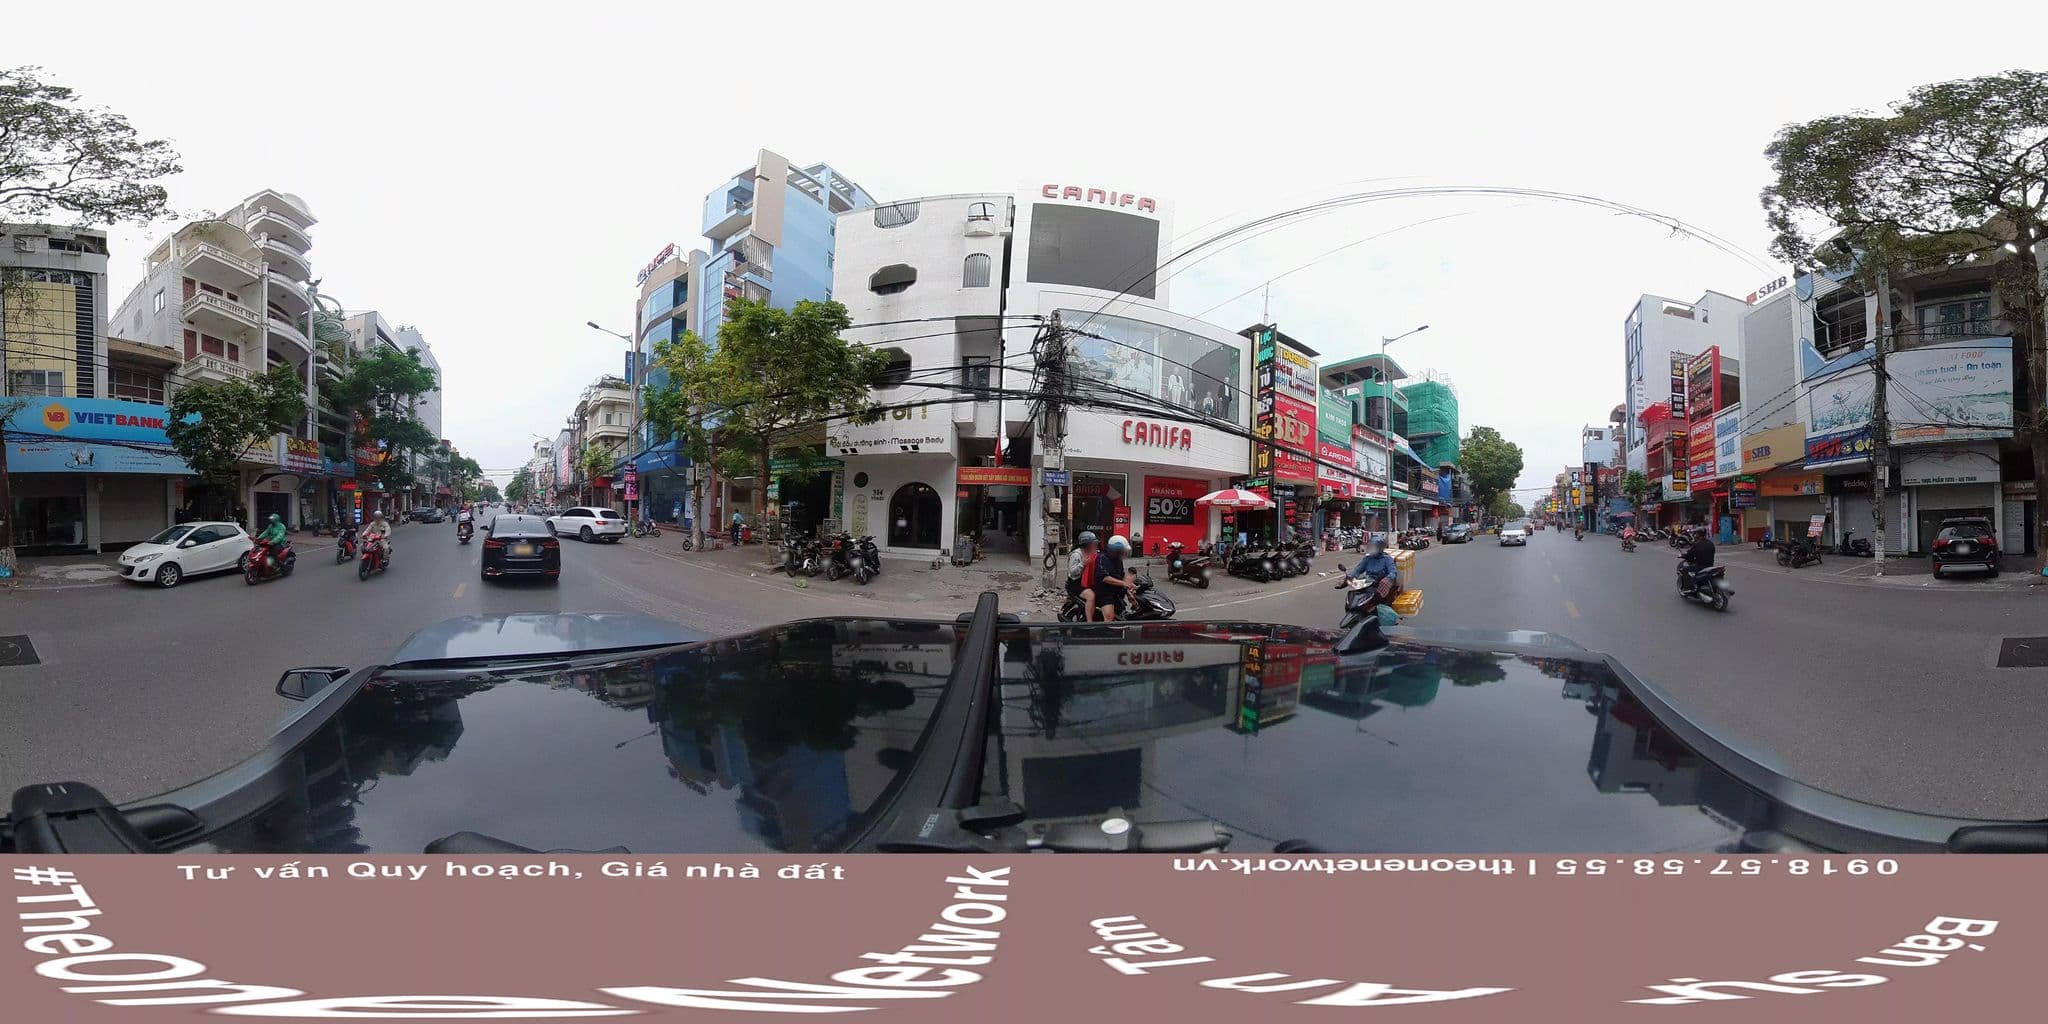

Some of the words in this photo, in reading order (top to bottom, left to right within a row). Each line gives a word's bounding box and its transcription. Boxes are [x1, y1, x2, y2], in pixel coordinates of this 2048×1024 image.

[1042, 184, 1157, 213] CANIFA
[1759, 276, 1787, 298] SHB
[1967, 363, 1978, 371] An
[74, 412, 165, 429] VIETBANK
[1274, 409, 1309, 444] BẾP
[890, 437, 924, 445] Massage
[925, 436, 944, 445] Body
[1122, 420, 1193, 450] CANIFA
[1328, 451, 1352, 464] ARISTON
[1752, 446, 1771, 459] SHB
[1149, 497, 1188, 516] 50%
